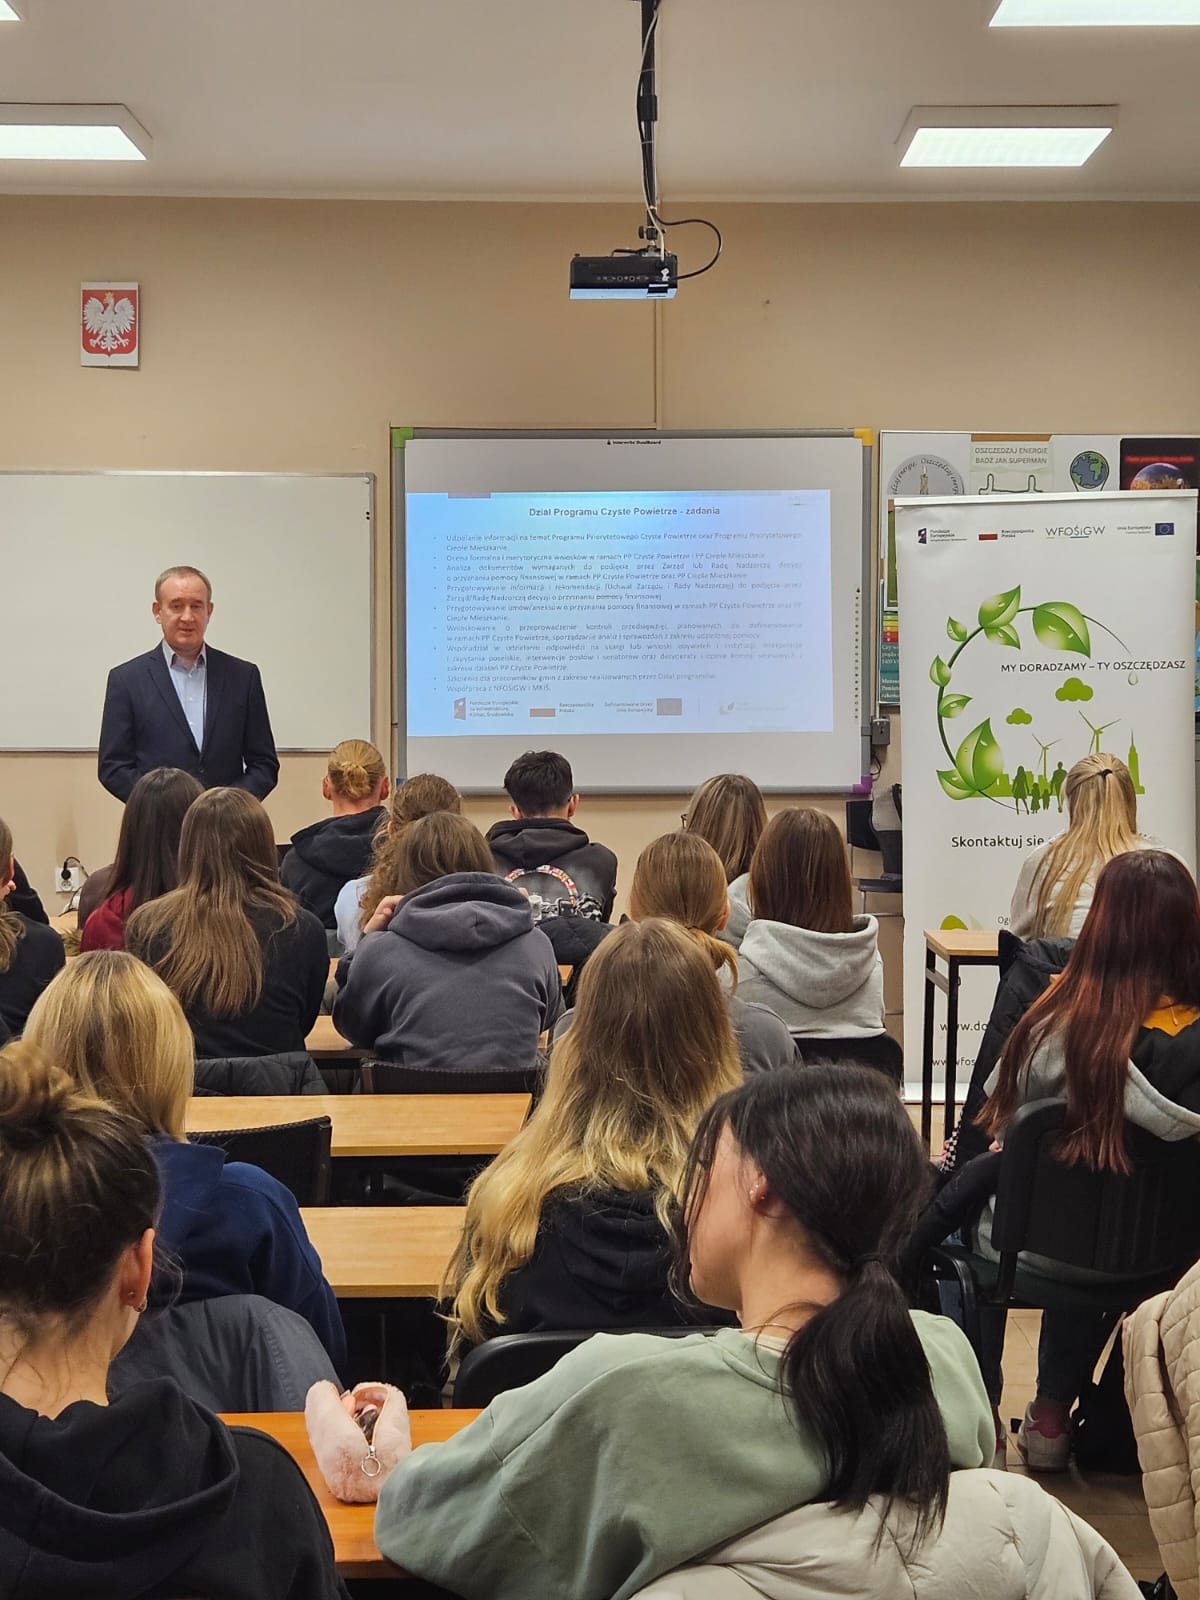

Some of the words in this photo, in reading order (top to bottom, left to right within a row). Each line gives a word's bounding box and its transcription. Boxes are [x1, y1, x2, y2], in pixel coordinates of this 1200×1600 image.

[553, 507, 598, 518] Programu
[600, 507, 631, 518] Czyste
[633, 507, 678, 516] Powietrze
[685, 506, 721, 515] zadania
[1001, 664, 1017, 673] MY
[1019, 662, 1087, 673] DORADZAMY
[1097, 661, 1111, 671] TY
[1113, 660, 1186, 672] OSZCZĘDZASZ
[951, 835, 1022, 849] Skontaktuj
